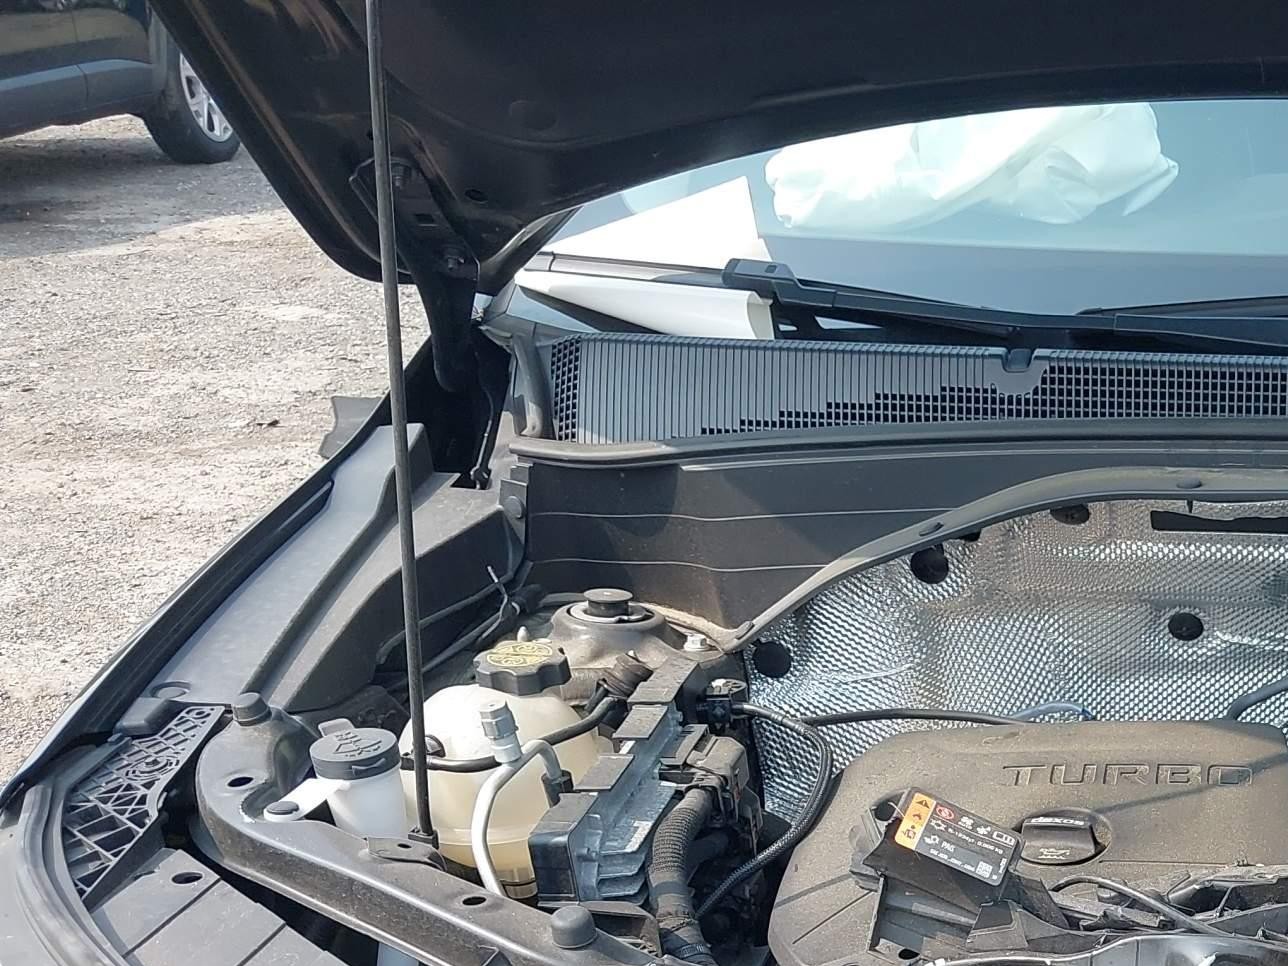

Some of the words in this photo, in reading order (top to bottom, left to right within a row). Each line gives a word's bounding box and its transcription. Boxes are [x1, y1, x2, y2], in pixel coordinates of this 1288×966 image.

[1002, 763, 1253, 787] TURBO
[1030, 816, 1085, 826] dexos
[941, 841, 956, 853] PAG
